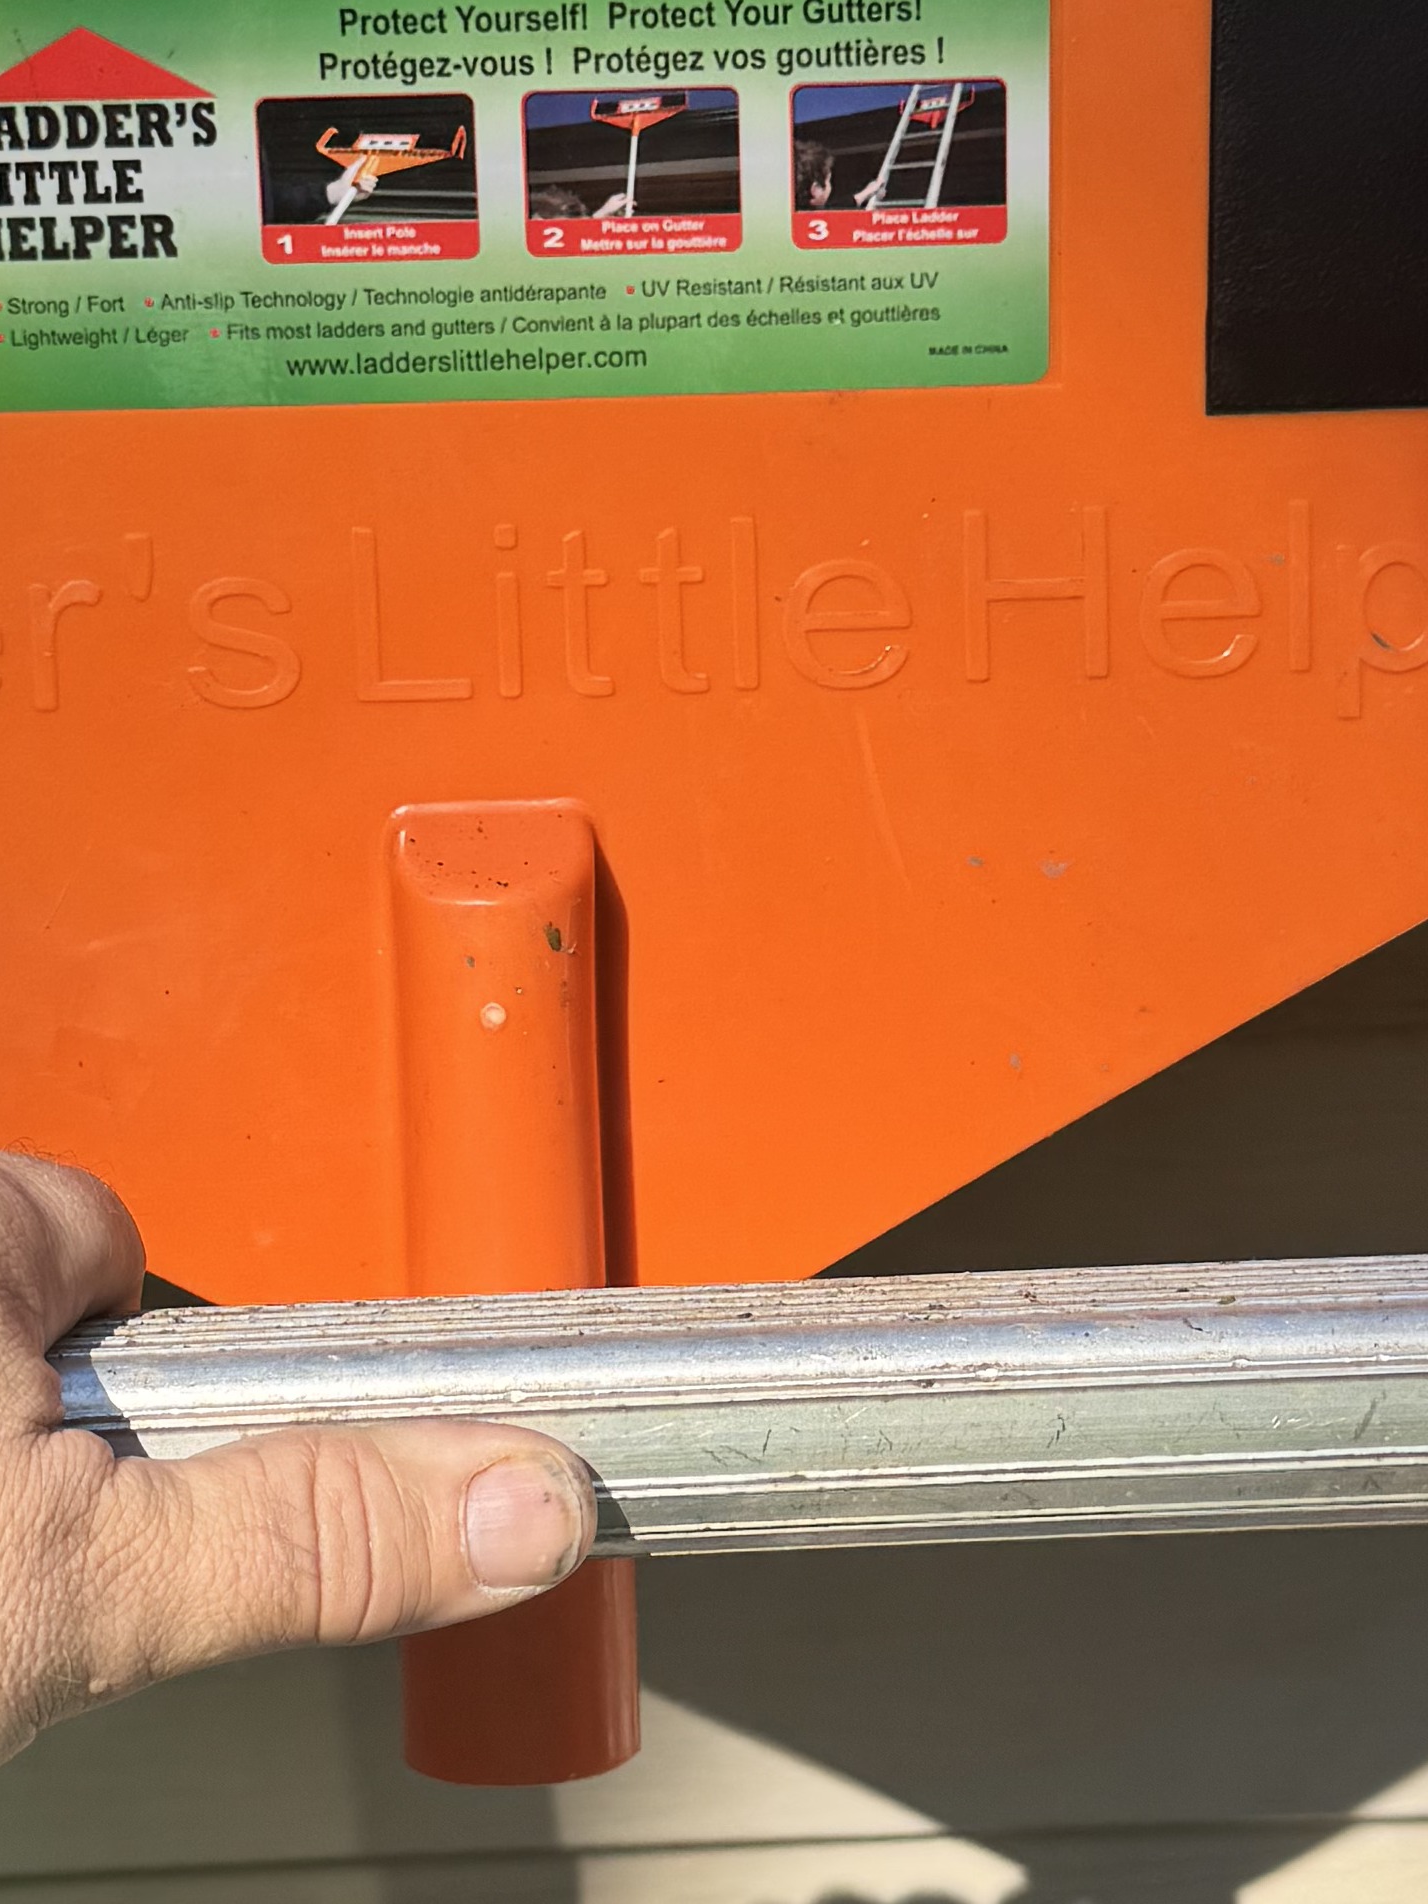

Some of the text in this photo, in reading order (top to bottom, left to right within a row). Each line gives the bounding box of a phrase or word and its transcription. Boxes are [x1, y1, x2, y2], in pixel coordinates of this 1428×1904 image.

[339, 7, 447, 36] Protect
[455, 2, 588, 34] Yourself!
[608, 1, 716, 30] Protect
[319, 49, 535, 86] Protégez-vous
[573, 45, 704, 79] Protégez
[713, 48, 766, 70] vos
[776, 37, 926, 76] gouttières
[601, 219, 706, 235] Place on Gutter
[872, 210, 960, 225] Place Ladder
[344, 226, 416, 240] Insert Pole
[542, 227, 565, 248] 2
[807, 219, 829, 241] 3
[852, 229, 895, 243] Placer
[957, 228, 979, 239] sur
[277, 234, 293, 255] 1
[321, 243, 441, 258] Insérer le manche
[580, 238, 623, 252] Mettre
[626, 239, 649, 251] sur
[651, 236, 664, 249] la
[7, 297, 70, 318] Strong
[88, 297, 125, 313] Fort
[160, 293, 235, 314] Anti-slip
[243, 290, 346, 312] Technology
[363, 286, 474, 308] Technologie
[480, 283, 606, 304] antidérapante
[641, 280, 670, 298] UV
[676, 277, 763, 297] Resistant
[779, 273, 866, 294] Résistant
[871, 277, 903, 290] aux
[910, 272, 939, 290] UV
[10, 327, 118, 351] Lightweight
[135, 327, 189, 347] Léger
[226, 323, 261, 341] Fits
[266, 323, 312, 341] most
[317, 320, 385, 339] ladders
[391, 319, 426, 337] and
[431, 319, 495, 341] gutters
[512, 315, 594, 335] Convient
[599, 316, 611, 332] à
[617, 315, 633, 332] la
[639, 311, 702, 333] plupart
[707, 309, 741, 328] des
[746, 307, 822, 328] échelles
[827, 308, 845, 324] et
[850, 304, 941, 327] gouttières
[286, 347, 647, 377] www.ladderslittlehelper.com
[352, 516, 913, 702] Little
